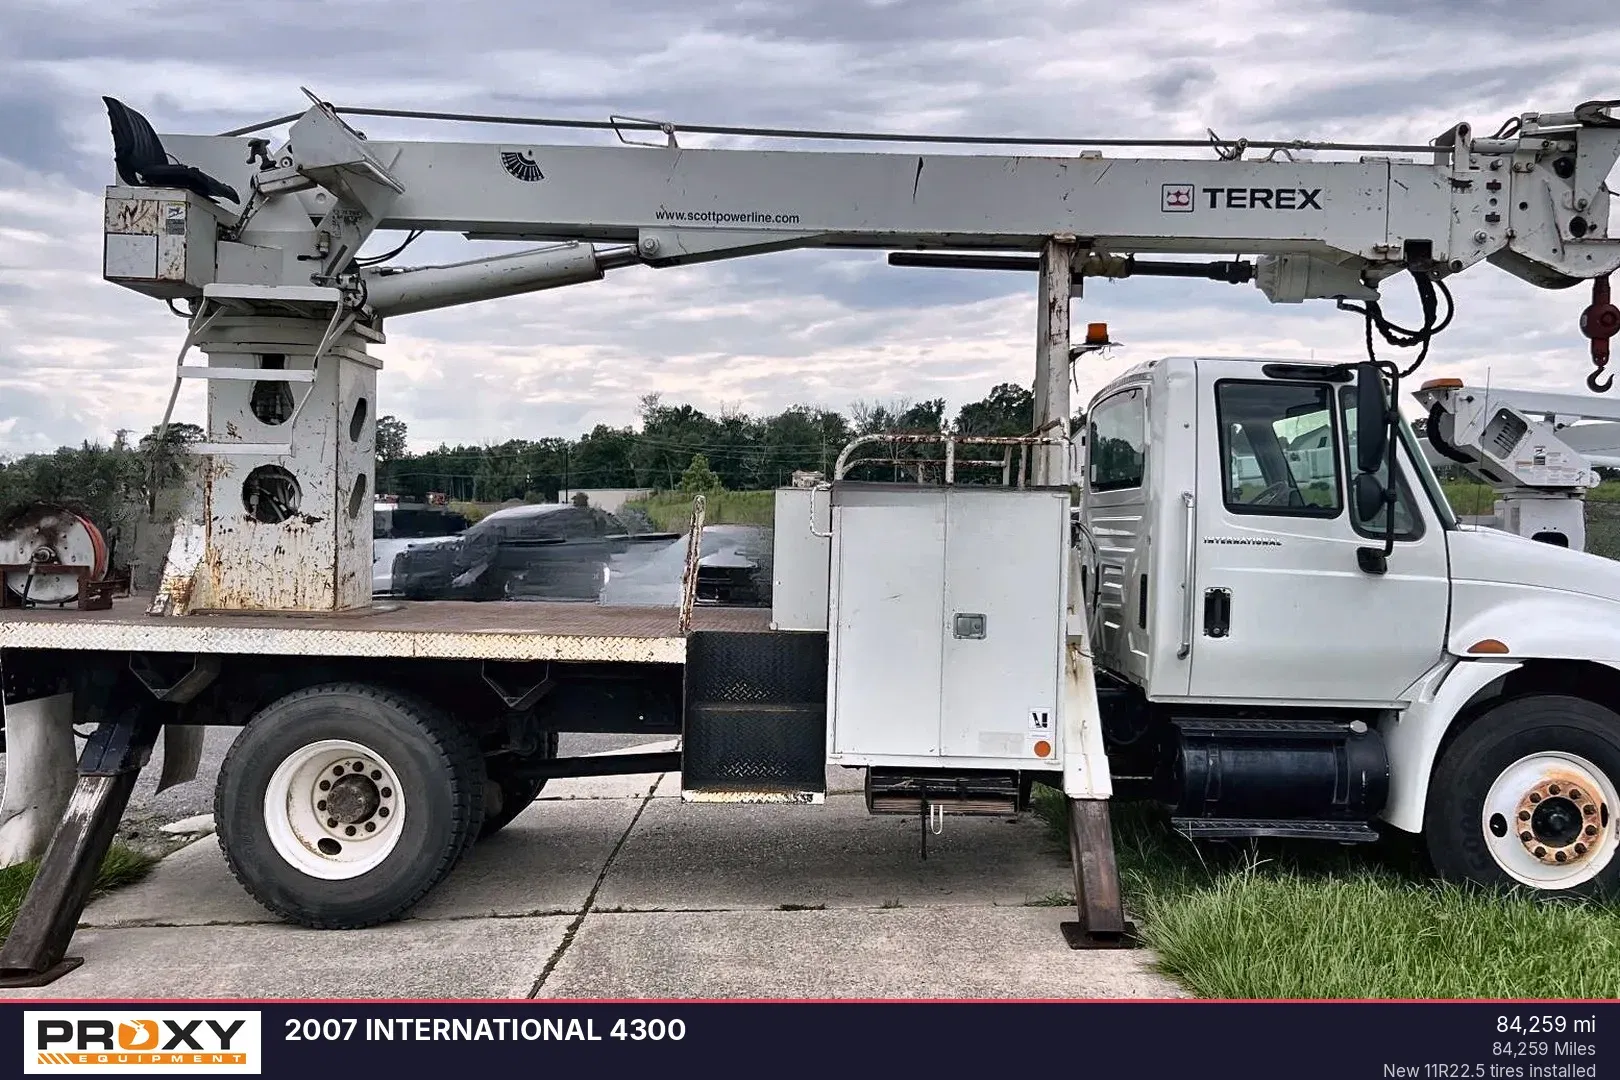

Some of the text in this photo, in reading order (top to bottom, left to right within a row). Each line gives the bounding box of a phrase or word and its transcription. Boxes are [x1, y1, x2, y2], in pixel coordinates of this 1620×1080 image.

[1202, 188, 1322, 210] TEREX
[655, 211, 800, 224] www.scottpowerline.com
[1203, 536, 1283, 546] INTERNATIONAL
